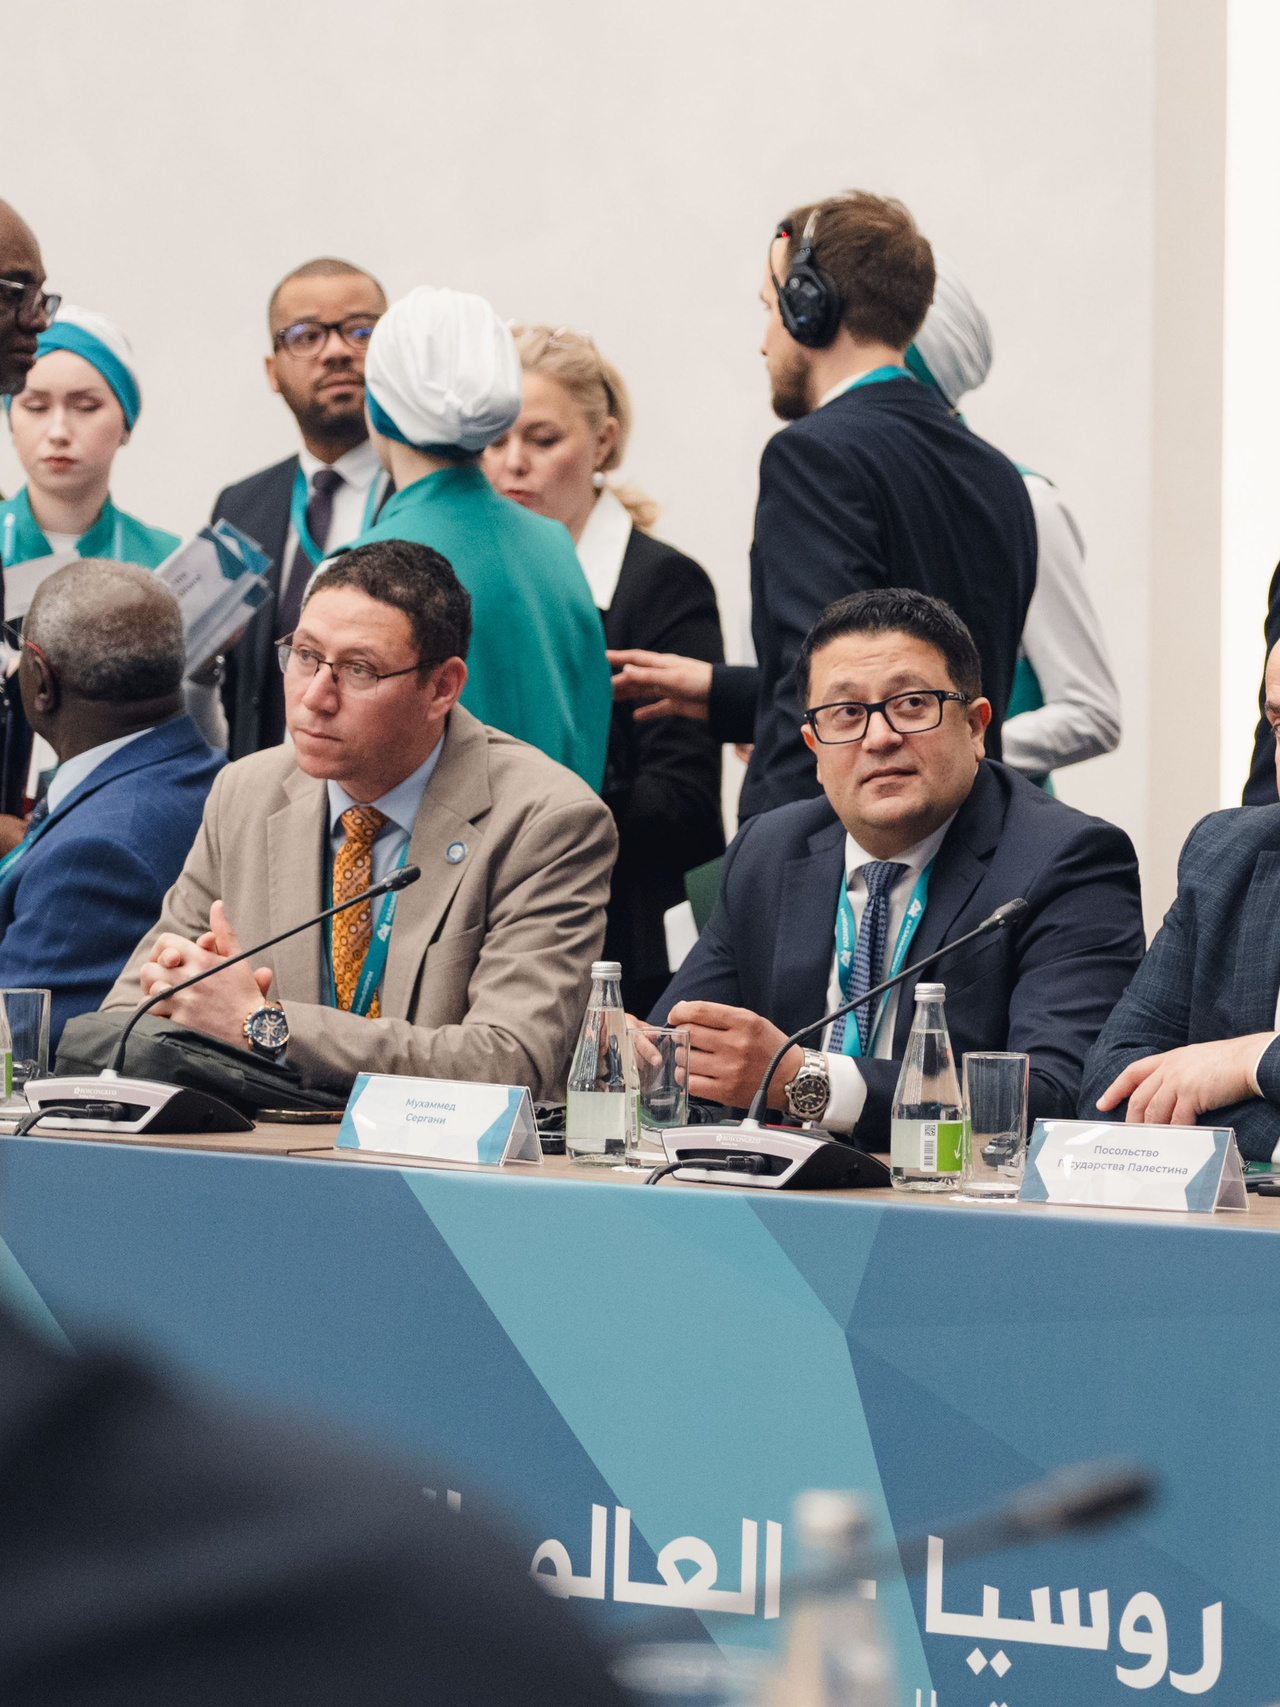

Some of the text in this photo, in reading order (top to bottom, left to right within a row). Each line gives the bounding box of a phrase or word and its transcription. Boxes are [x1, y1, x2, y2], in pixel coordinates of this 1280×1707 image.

[405, 1098, 456, 1111] Мухаммед
[405, 1113, 447, 1124] Сергани
[1094, 1145, 1160, 1158] Посольство
[1057, 1159, 1189, 1175] Гсударства Палестина
[925, 1534, 1222, 1695] روسيا
